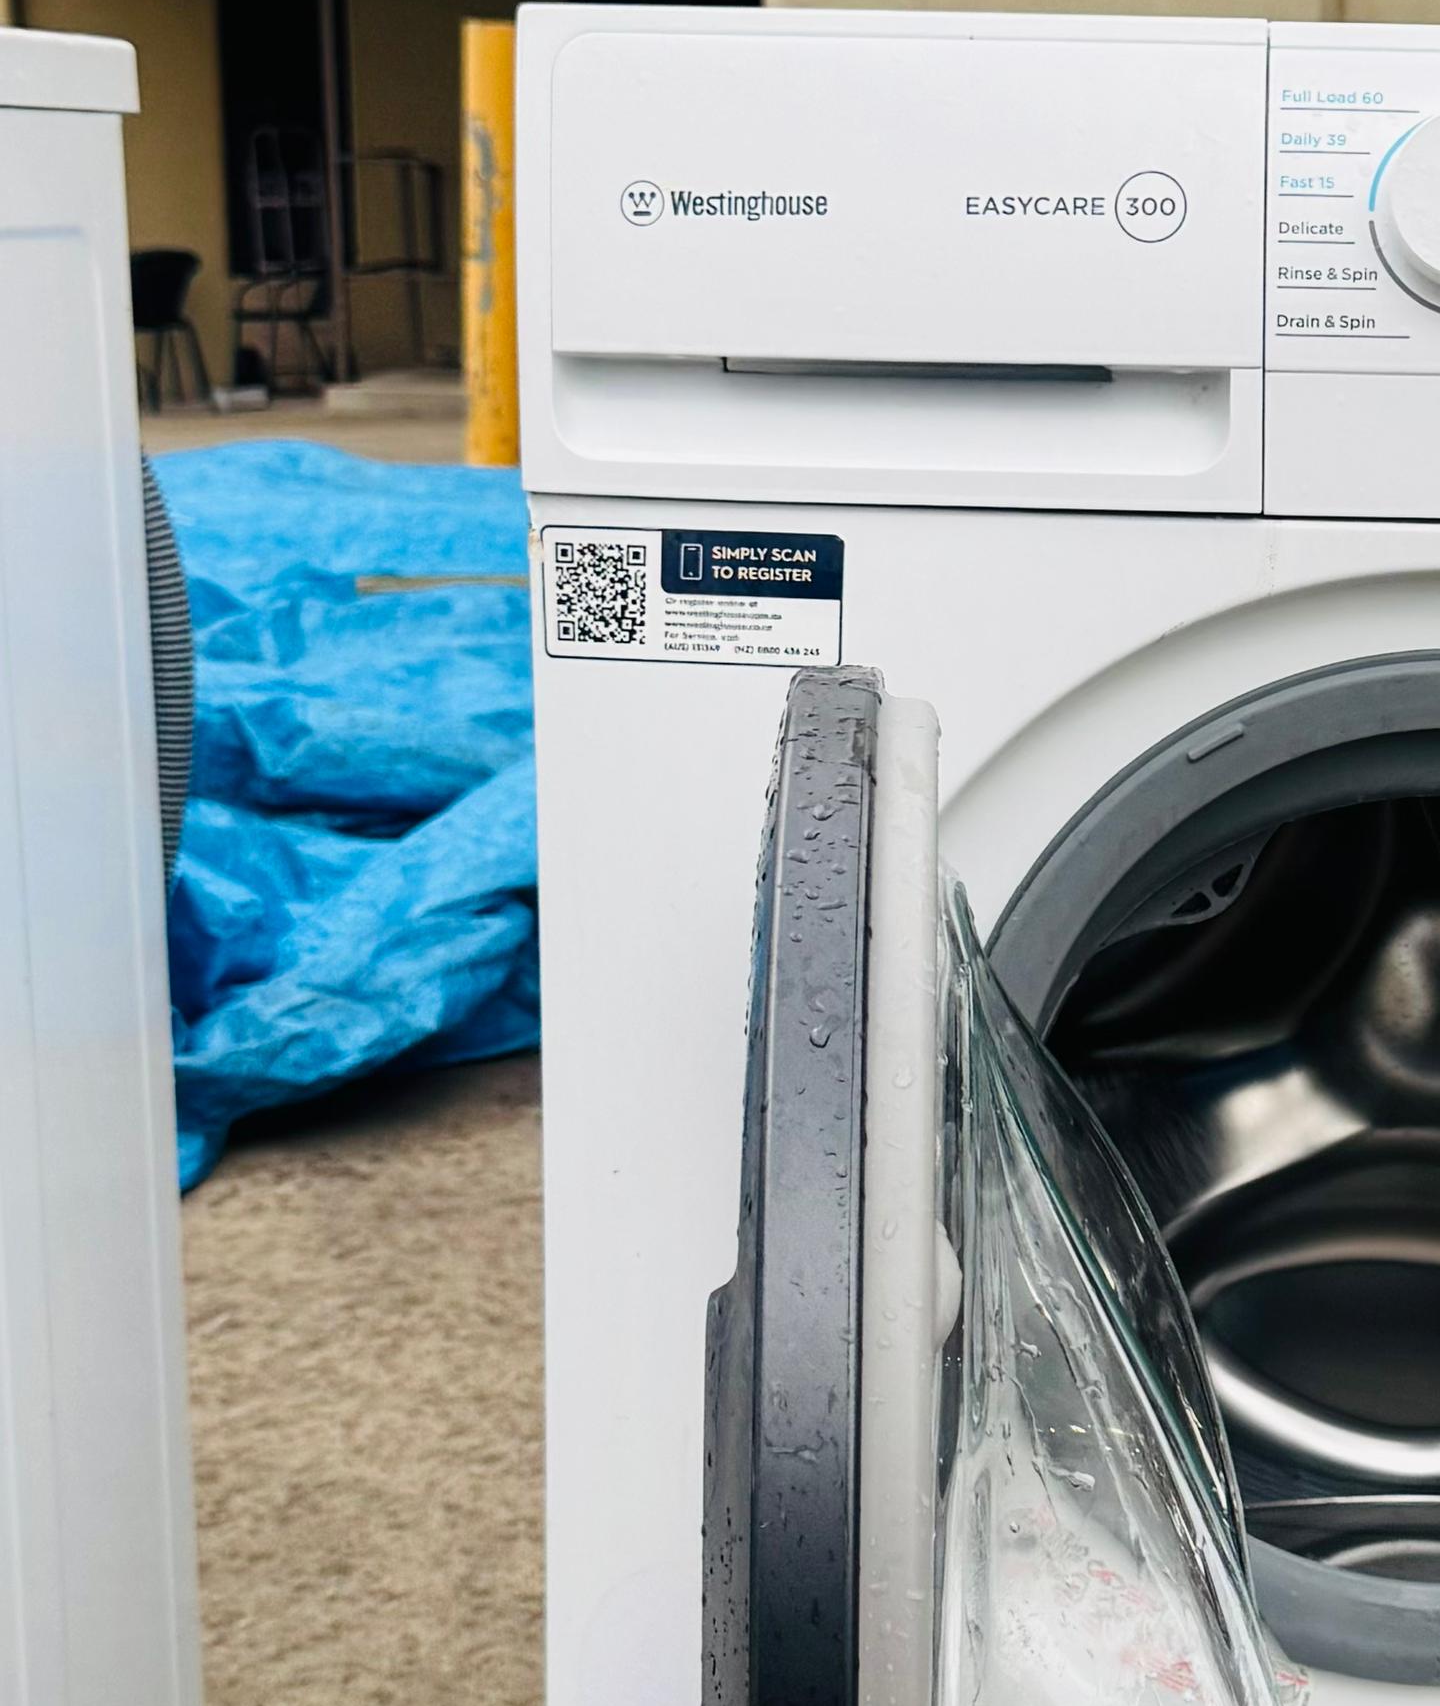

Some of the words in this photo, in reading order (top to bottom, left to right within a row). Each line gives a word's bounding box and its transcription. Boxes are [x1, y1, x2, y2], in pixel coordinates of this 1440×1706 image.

[1281, 90, 1312, 105] Full
[1315, 91, 1357, 105] Load
[1362, 92, 1384, 105] 60
[1280, 133, 1322, 148] Daily
[1326, 134, 1347, 147] 39
[1280, 176, 1316, 189] Fast
[1319, 177, 1335, 189] 15
[670, 190, 828, 221] Westinghouse
[965, 195, 1106, 217] EASYCARE
[1125, 196, 1177, 217] 300
[1279, 222, 1344, 236] Delicate
[1277, 267, 1323, 281] Rinse
[1326, 268, 1338, 281] &
[1341, 268, 1378, 284] Spin
[1276, 315, 1320, 329] Drain
[1324, 316, 1336, 330] &
[1339, 316, 1376, 332] Spin
[712, 546, 768, 562] SIMPLY
[771, 549, 817, 563] SCAN
[712, 566, 734, 580] TO
[737, 567, 812, 582] REGISTER
